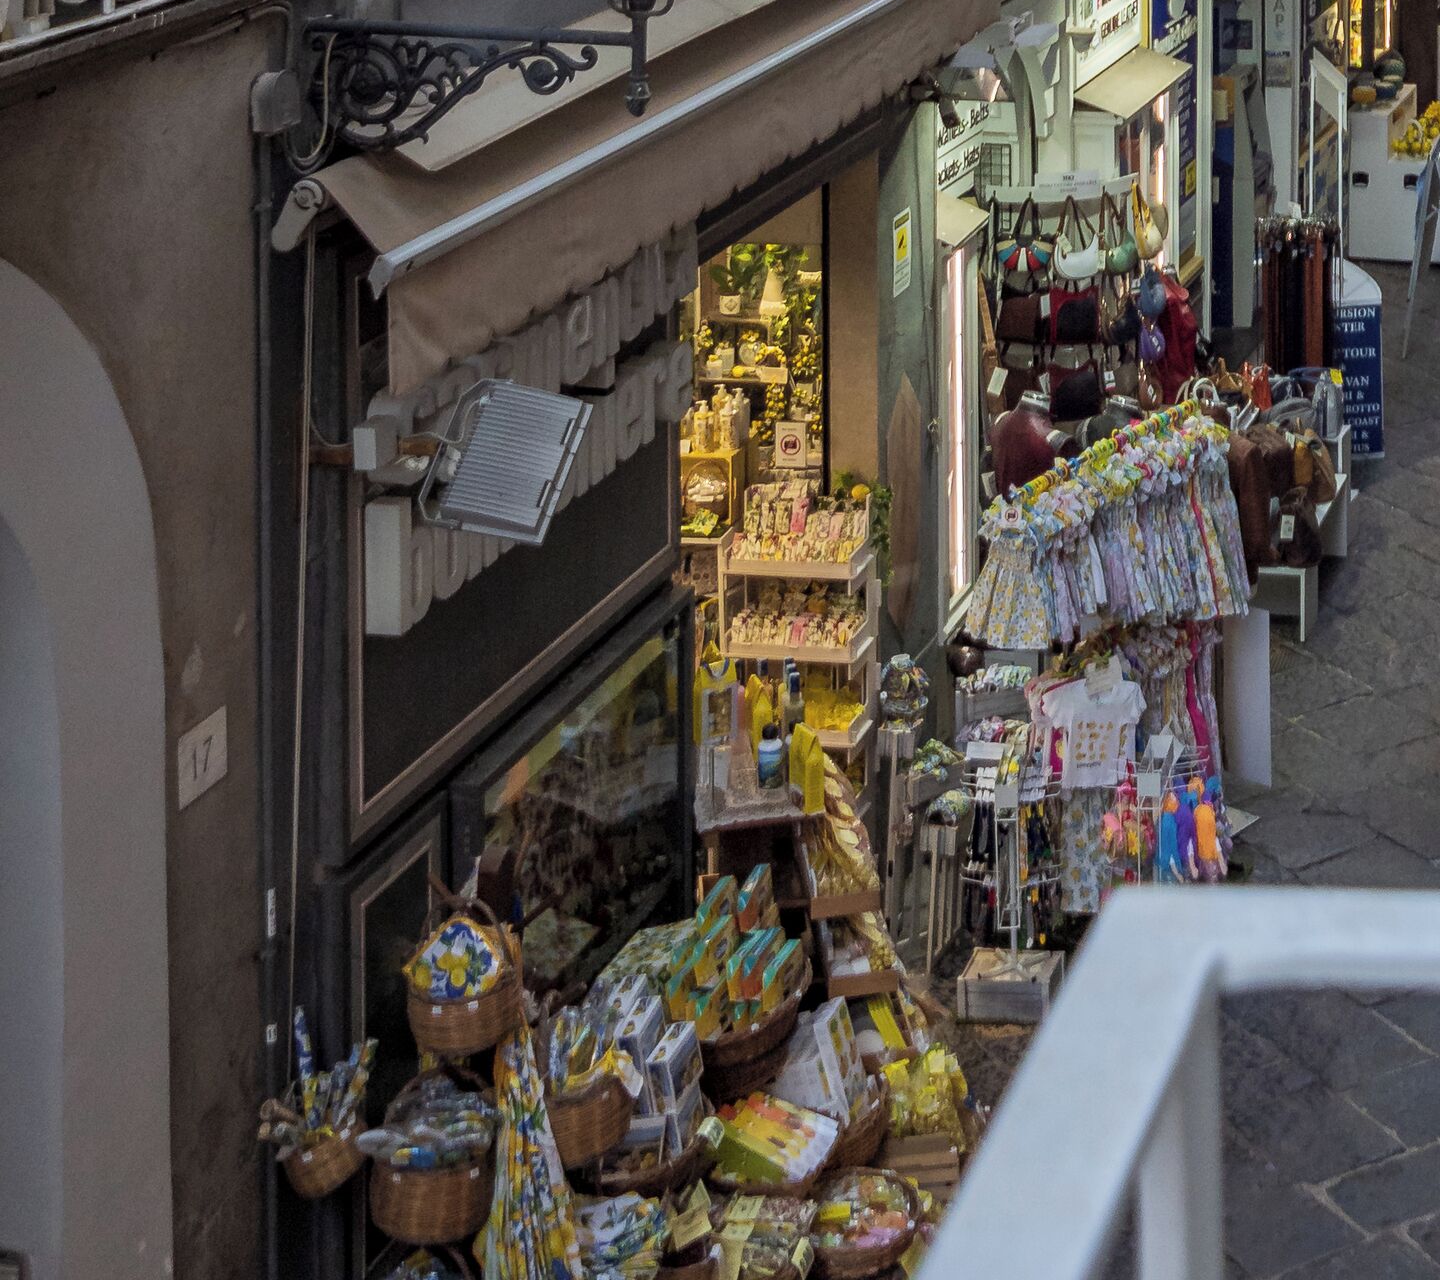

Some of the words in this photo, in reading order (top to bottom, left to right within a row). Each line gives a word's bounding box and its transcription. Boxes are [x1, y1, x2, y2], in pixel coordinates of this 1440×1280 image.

[970, 102, 990, 129] Belts
[1343, 347, 1377, 359] TOUR
[1345, 375, 1370, 388] VAN
[1345, 402, 1381, 414] ROTTO
[193, 734, 214, 781] 17
